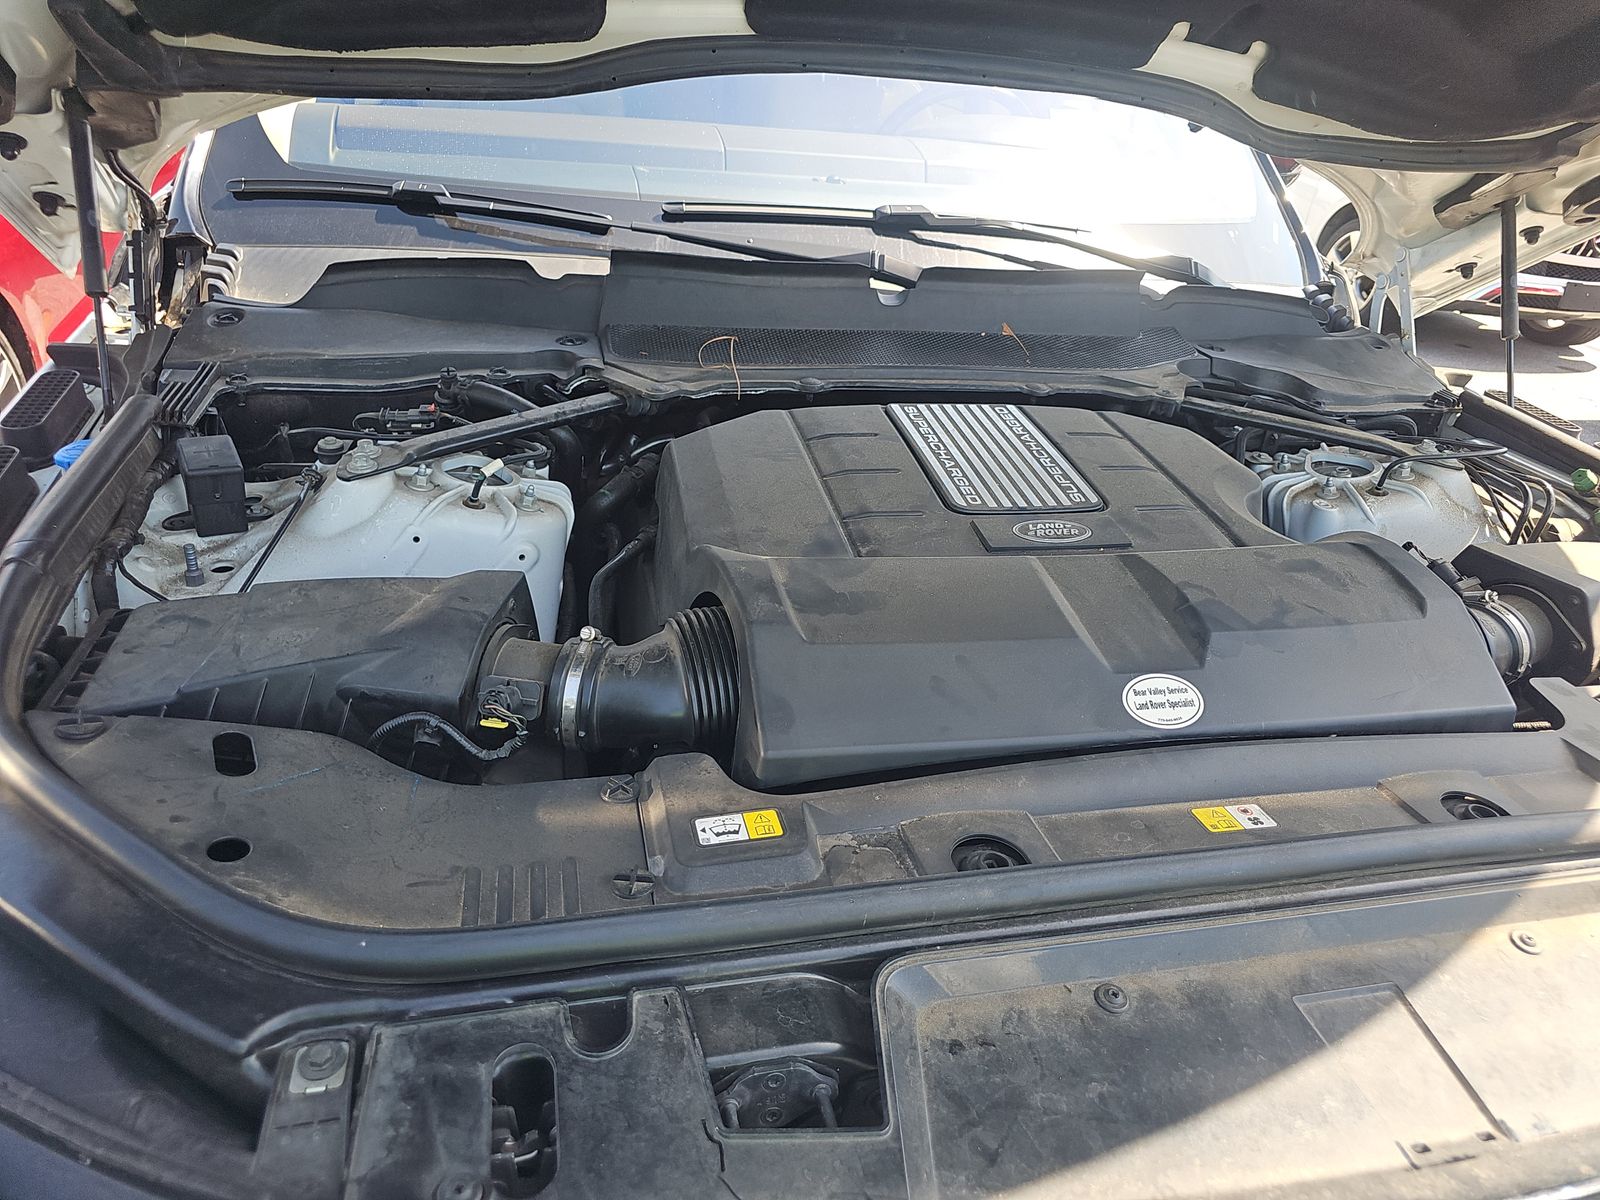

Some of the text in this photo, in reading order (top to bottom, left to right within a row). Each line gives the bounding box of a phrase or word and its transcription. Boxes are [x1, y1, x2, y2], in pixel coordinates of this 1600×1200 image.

[904, 405, 982, 506] SUPERCHARGED
[994, 406, 1086, 504] SUPERCHARGED
[1028, 523, 1064, 531] LAND
[1036, 528, 1080, 537] ROVER
[1132, 686, 1189, 697] Bear Valley Service
[1134, 698, 1196, 711] Land Rover Specialist
